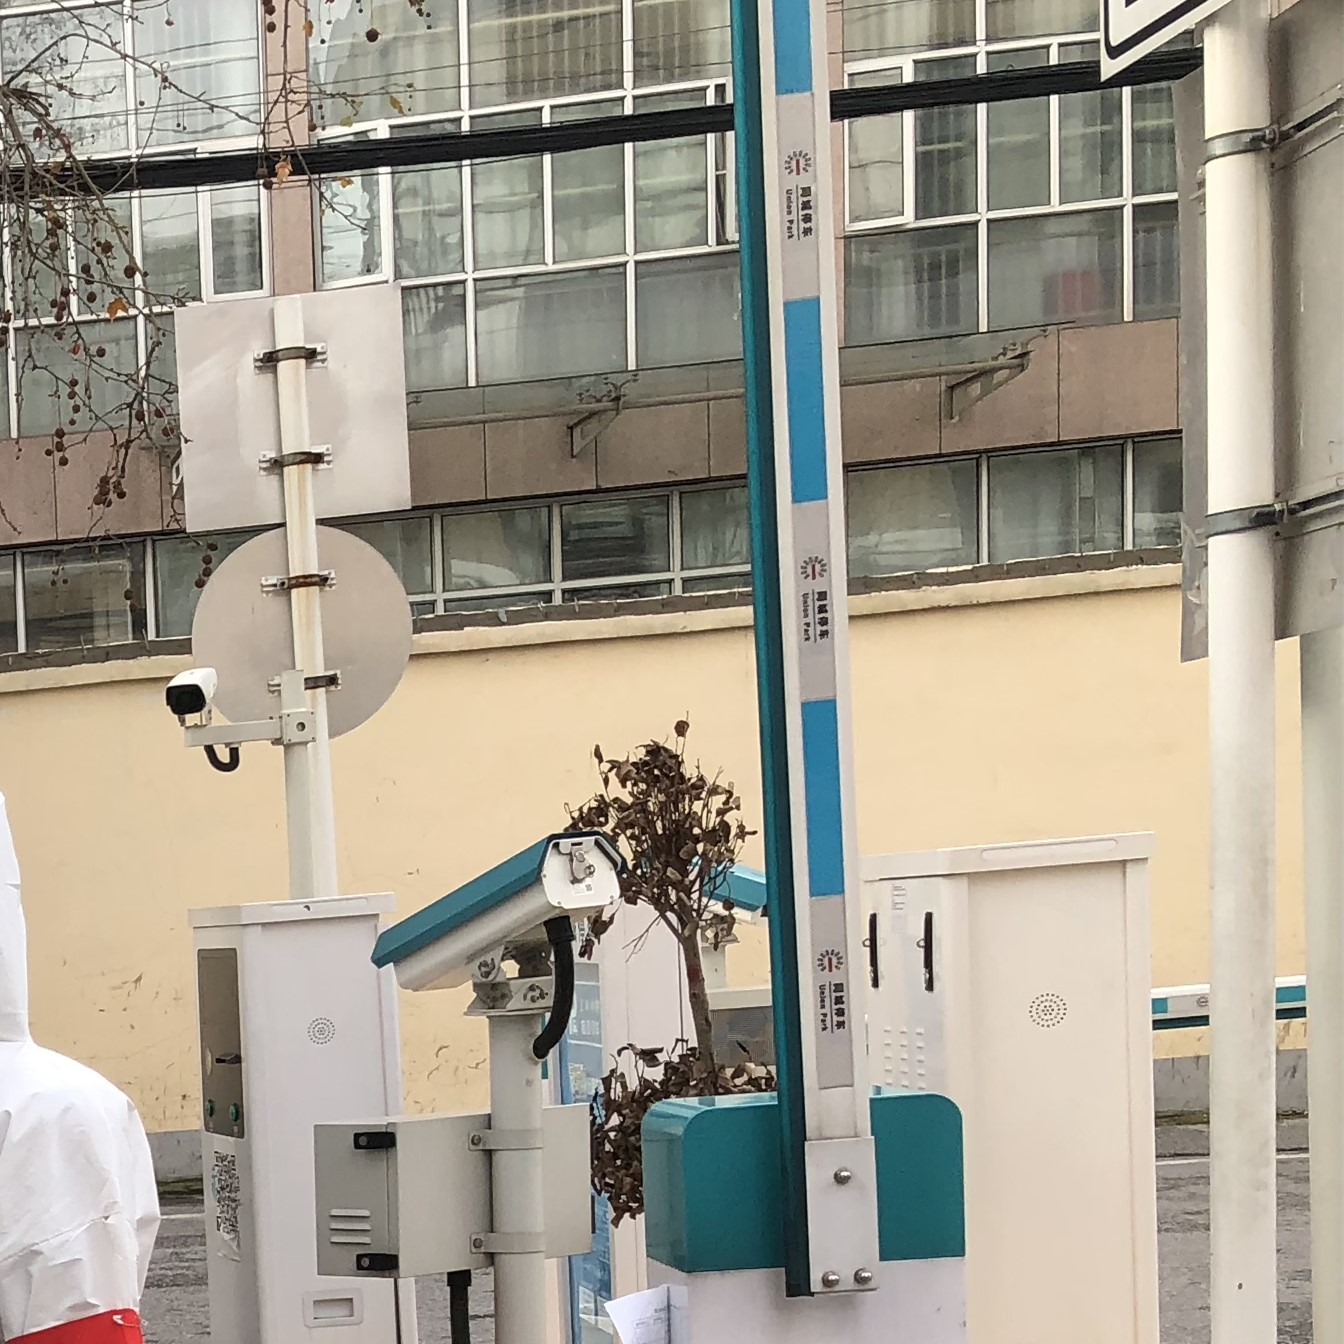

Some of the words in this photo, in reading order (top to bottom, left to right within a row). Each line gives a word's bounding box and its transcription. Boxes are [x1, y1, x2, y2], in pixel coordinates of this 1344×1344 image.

[786, 219, 795, 240] Park
[816, 590, 829, 640] 同城停车
[803, 622, 811, 642] Park
[833, 982, 846, 1030] 同城停车
[820, 1013, 828, 1032] Park
